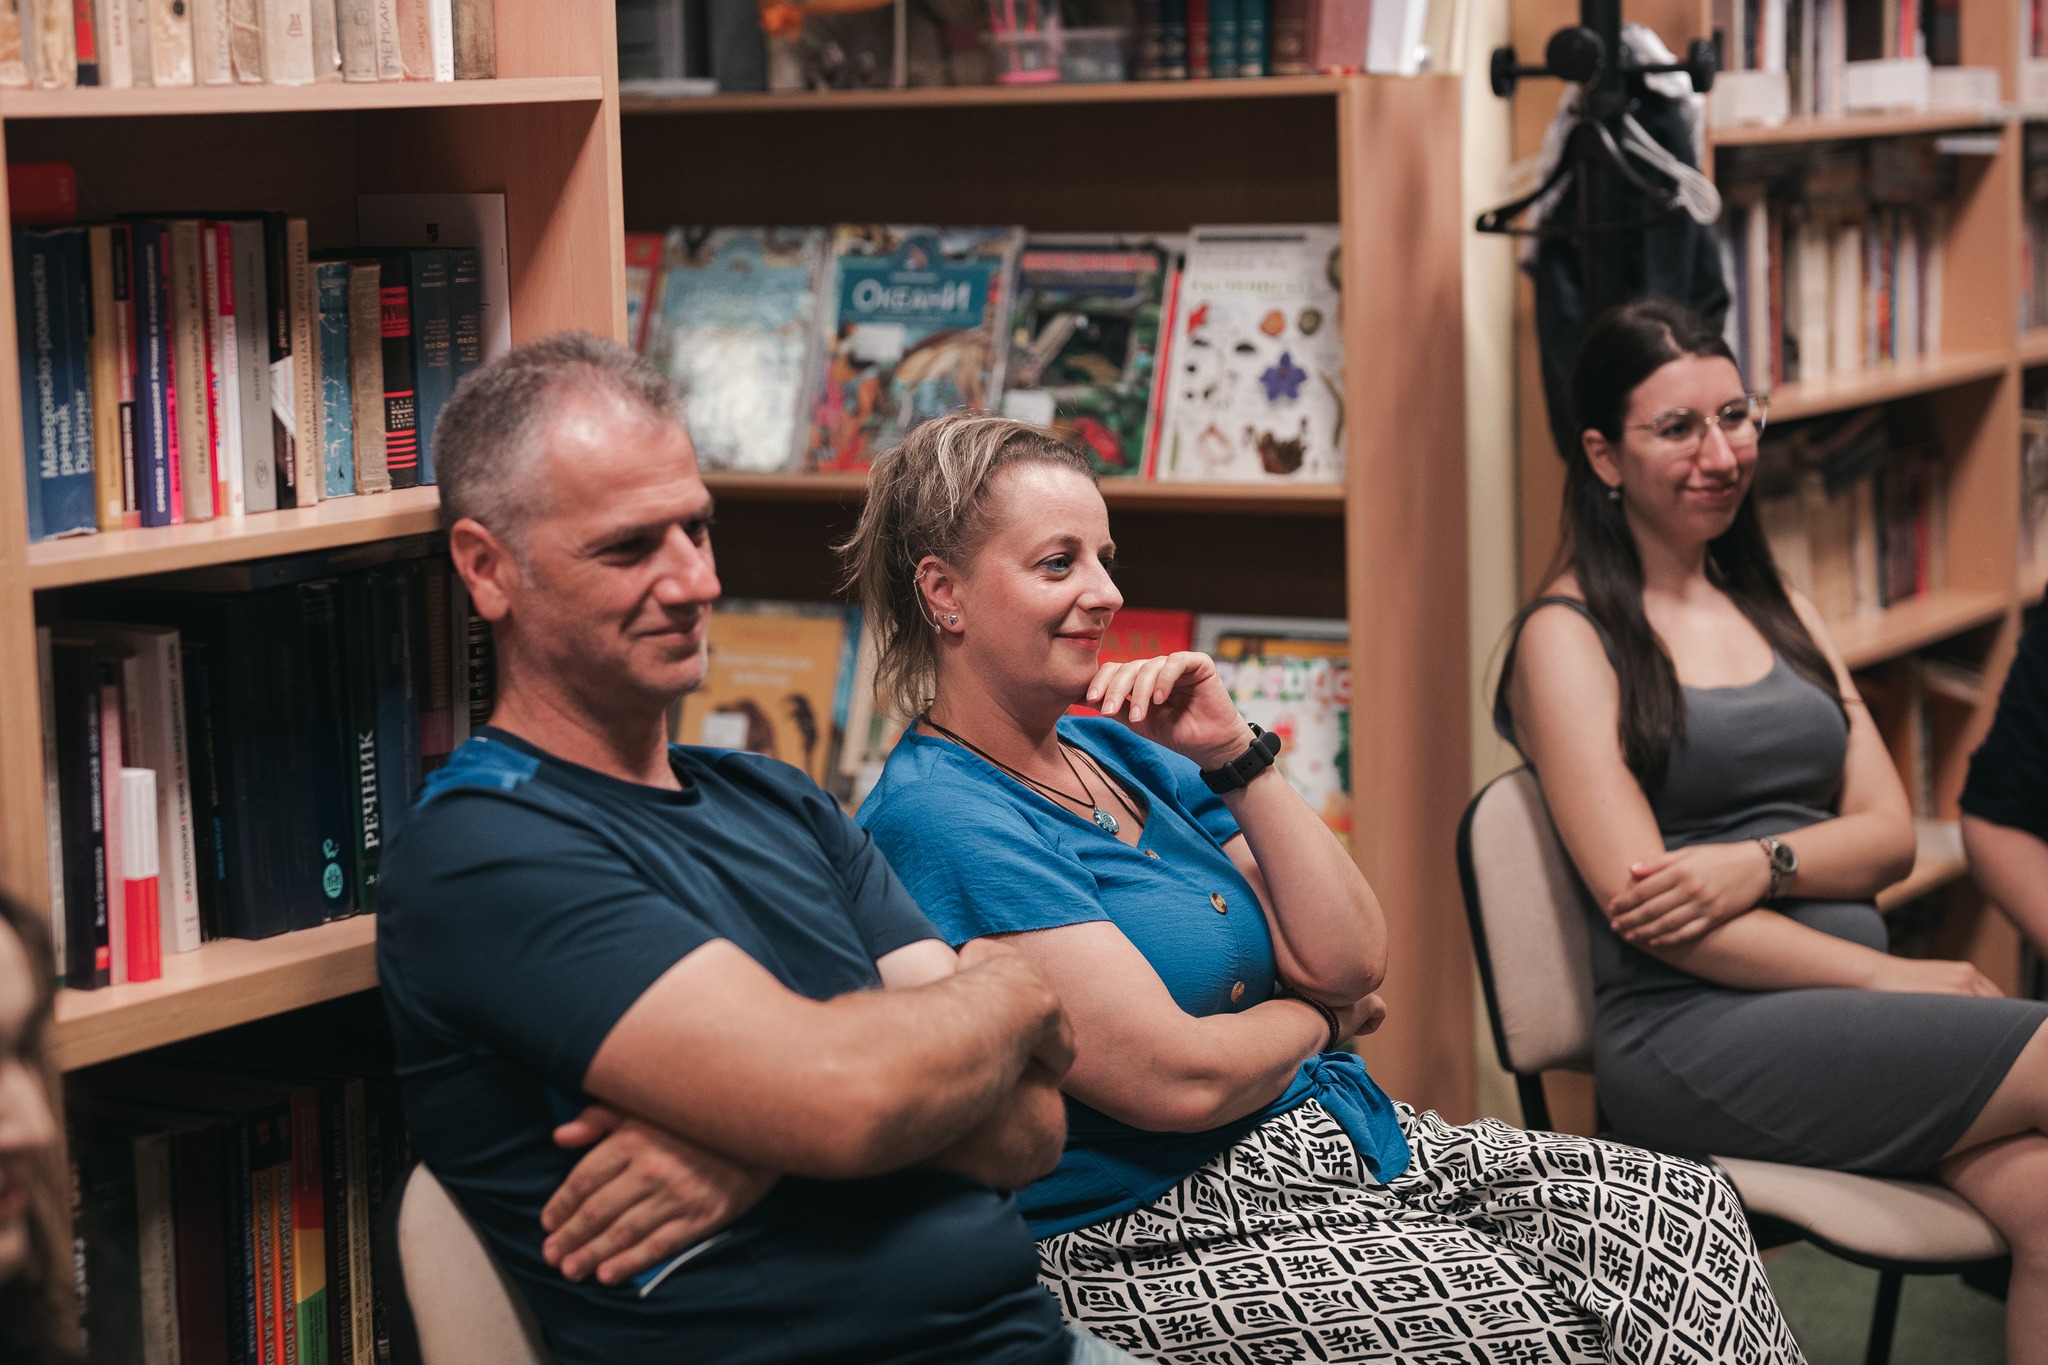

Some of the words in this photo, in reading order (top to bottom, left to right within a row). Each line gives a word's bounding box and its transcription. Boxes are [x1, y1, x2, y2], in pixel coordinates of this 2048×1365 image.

[357, 729, 382, 850] РЕЧНИК
[260, 1173, 273, 1266] ОКСФОРДСКИ
[279, 1167, 293, 1256] ОКСФОРДСКИ
[262, 1269, 275, 1318] РЕЧНИК
[282, 1261, 294, 1311] РЕЧНИК
[264, 1323, 275, 1339] ЗА
[284, 1315, 295, 1331] ЗА
